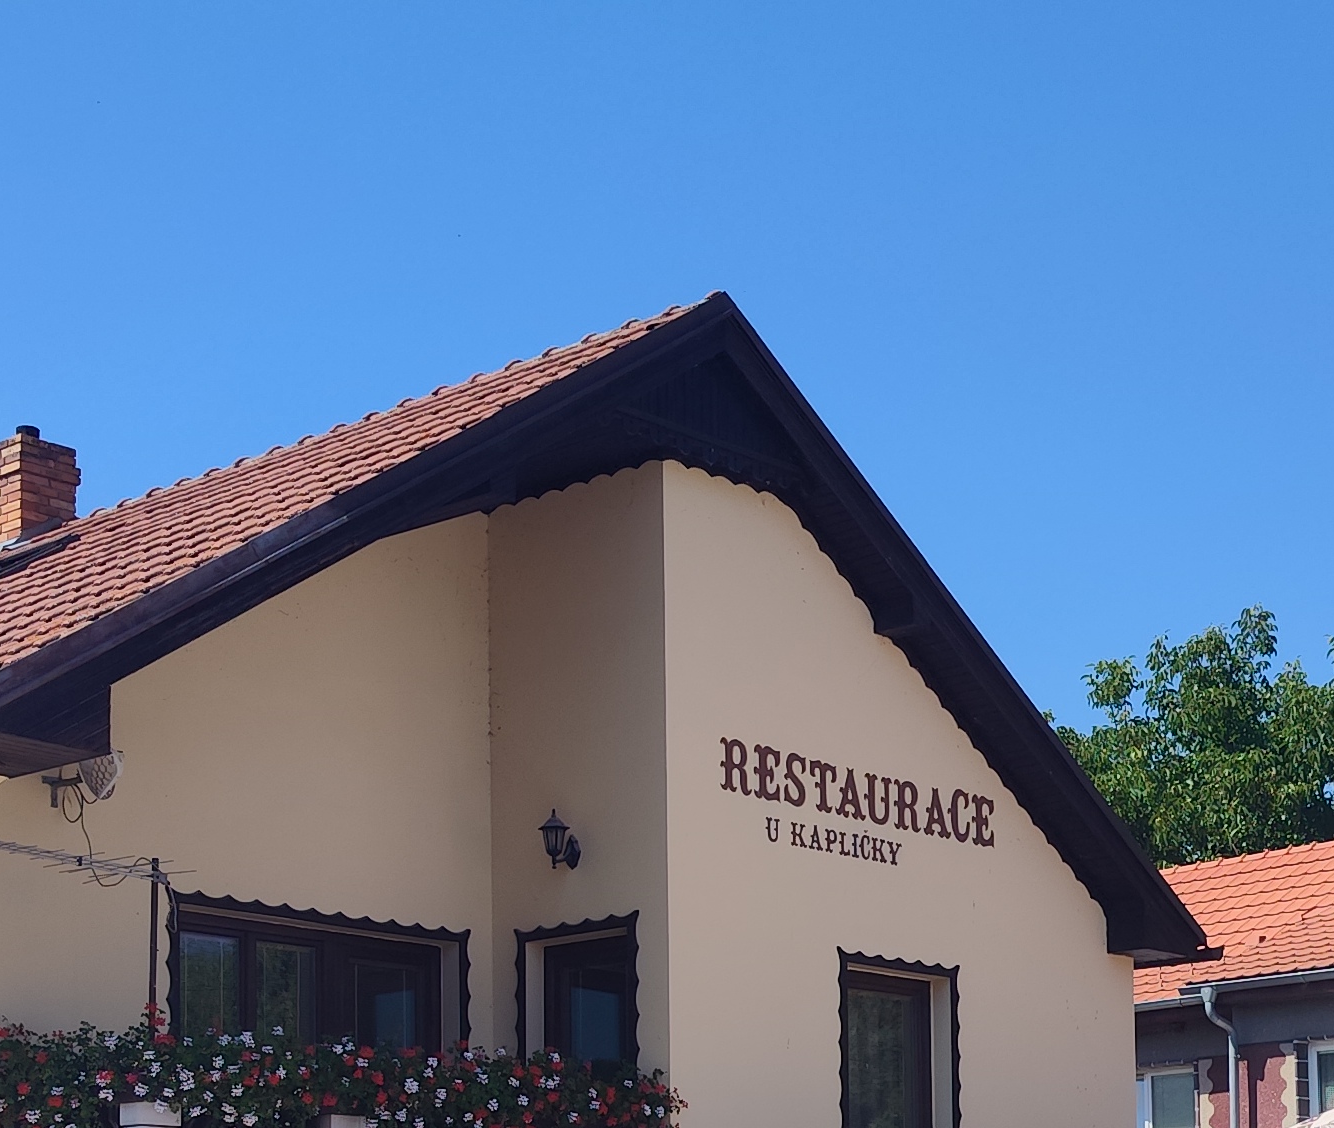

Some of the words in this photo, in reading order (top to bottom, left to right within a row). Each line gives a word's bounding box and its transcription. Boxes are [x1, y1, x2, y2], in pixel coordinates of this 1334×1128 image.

[720, 736, 995, 848] RESTAURACE
[766, 817, 780, 842] U
[791, 822, 902, 866] KAPLIČKY
